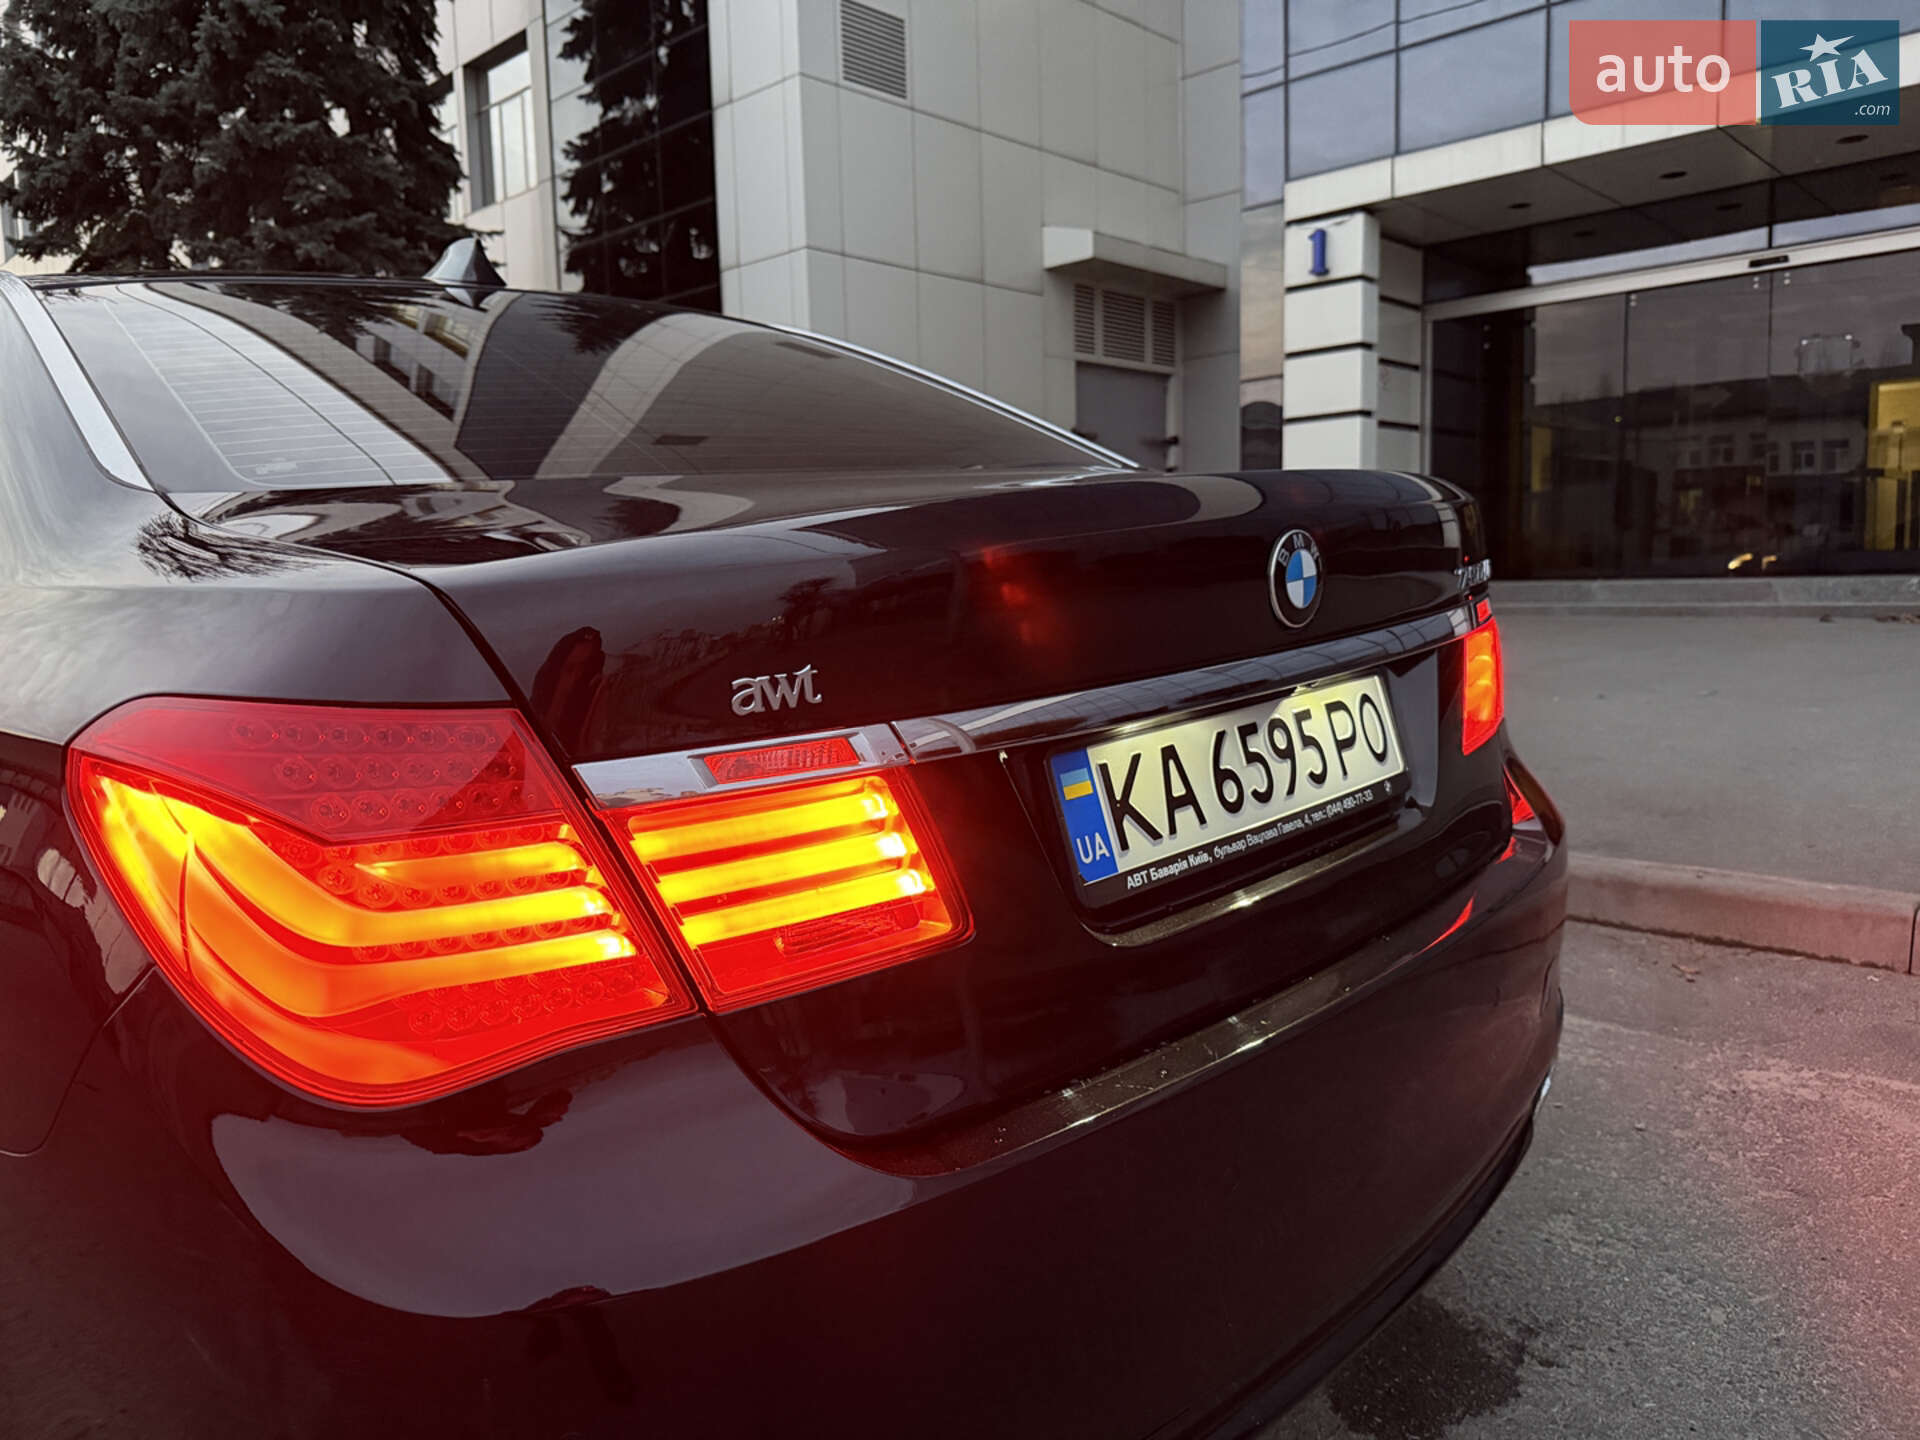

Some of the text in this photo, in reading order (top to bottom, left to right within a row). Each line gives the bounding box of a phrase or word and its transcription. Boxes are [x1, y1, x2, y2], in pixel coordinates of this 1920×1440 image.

[1308, 229, 1330, 276] 1
[1278, 533, 1320, 567] BMW
[731, 664, 822, 716] awt
[1098, 693, 1388, 851] KA 6595 PO
[1076, 832, 1110, 864] UA
[1127, 870, 1148, 889] АВТ
